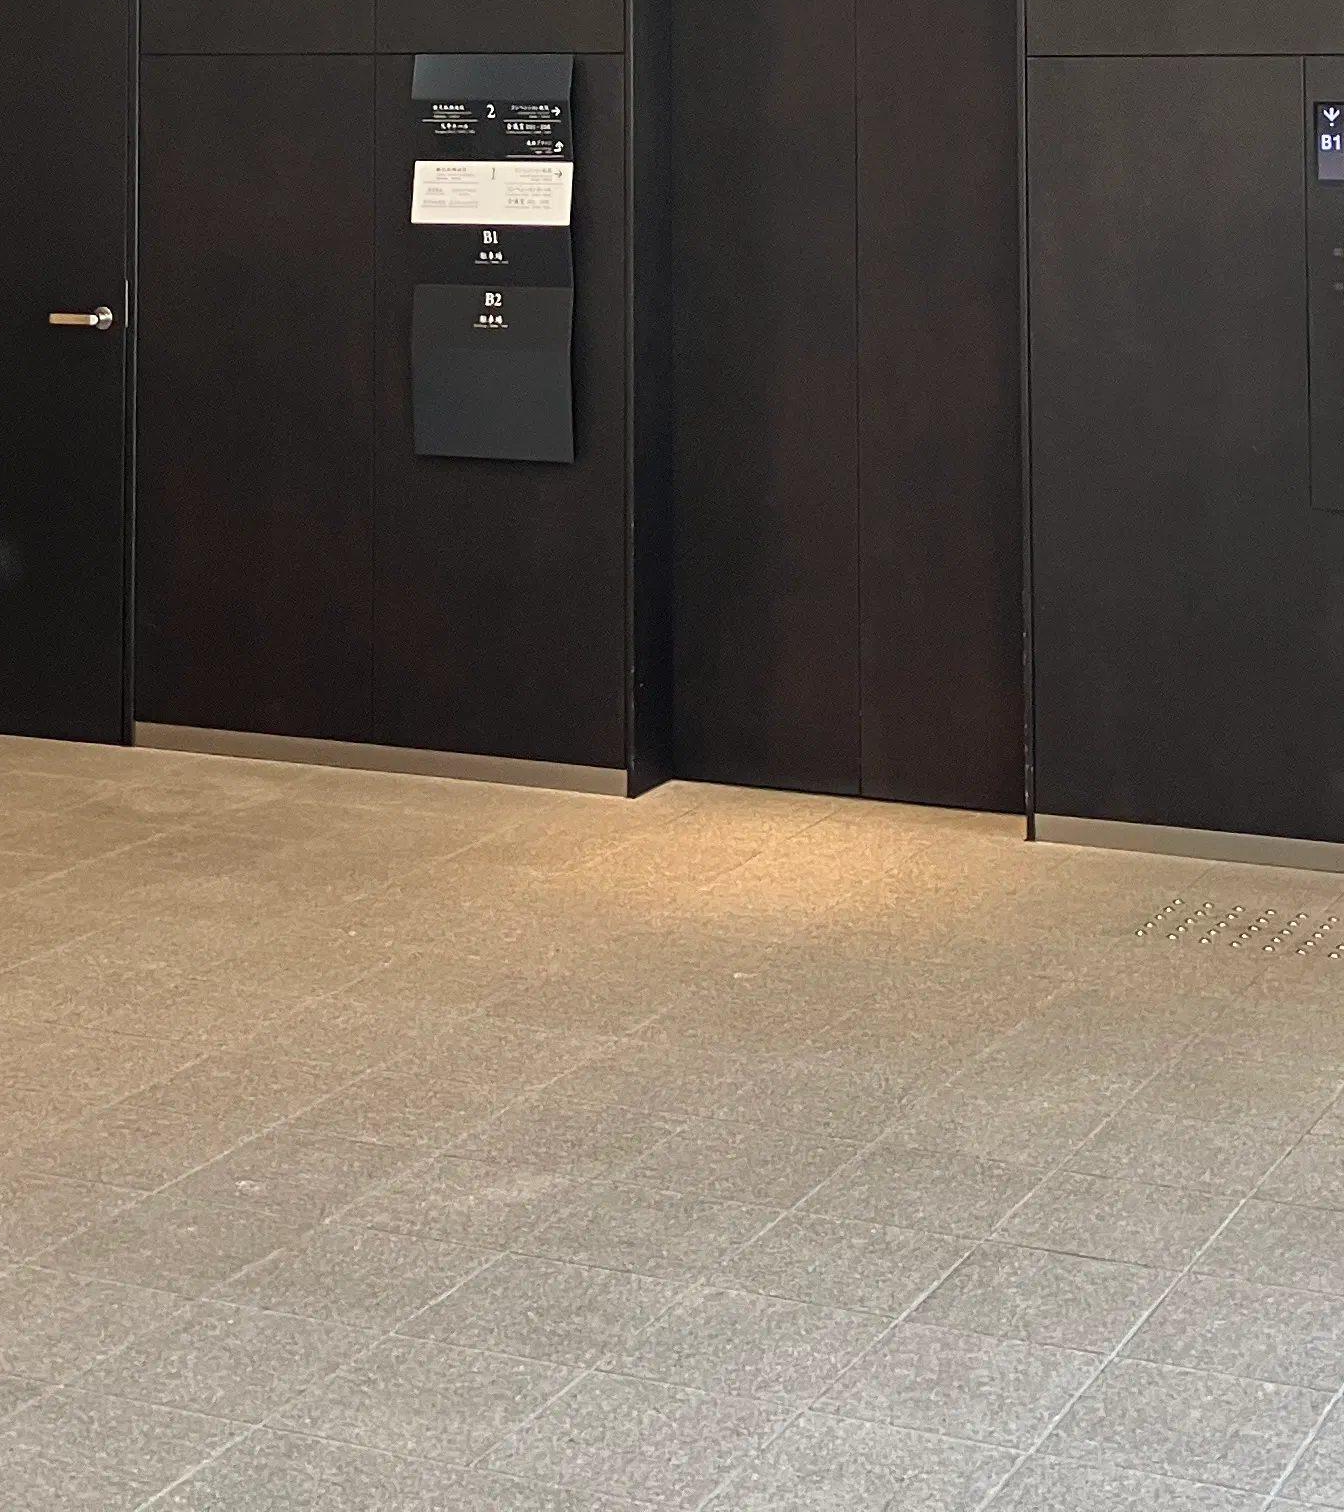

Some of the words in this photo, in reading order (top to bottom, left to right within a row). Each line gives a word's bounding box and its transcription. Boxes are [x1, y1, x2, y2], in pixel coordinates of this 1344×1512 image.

[486, 104, 496, 119] 2
[1321, 134, 1341, 151] B1
[482, 230, 499, 244] B1
[484, 292, 502, 307] B2
